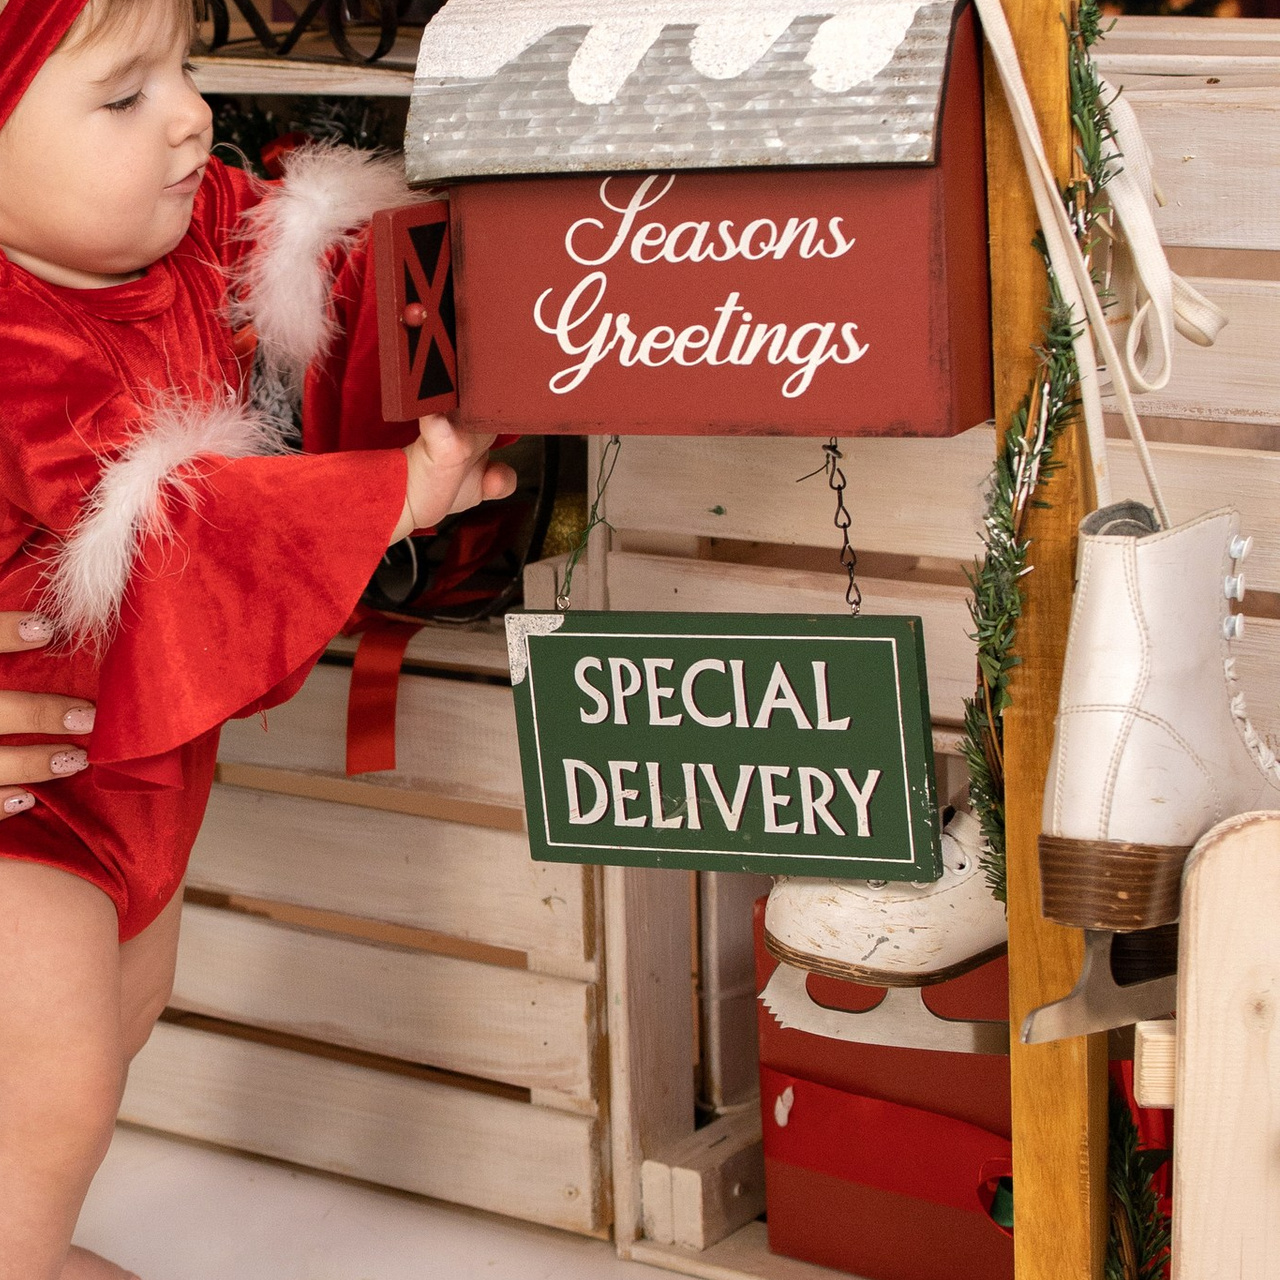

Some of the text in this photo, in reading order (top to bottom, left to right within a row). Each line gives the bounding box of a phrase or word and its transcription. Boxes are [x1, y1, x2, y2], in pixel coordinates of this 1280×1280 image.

[564, 174, 856, 266] Seasons
[533, 270, 870, 399] Greetings
[573, 655, 852, 732] SPECIAL
[561, 757, 882, 838] DELIVERY
